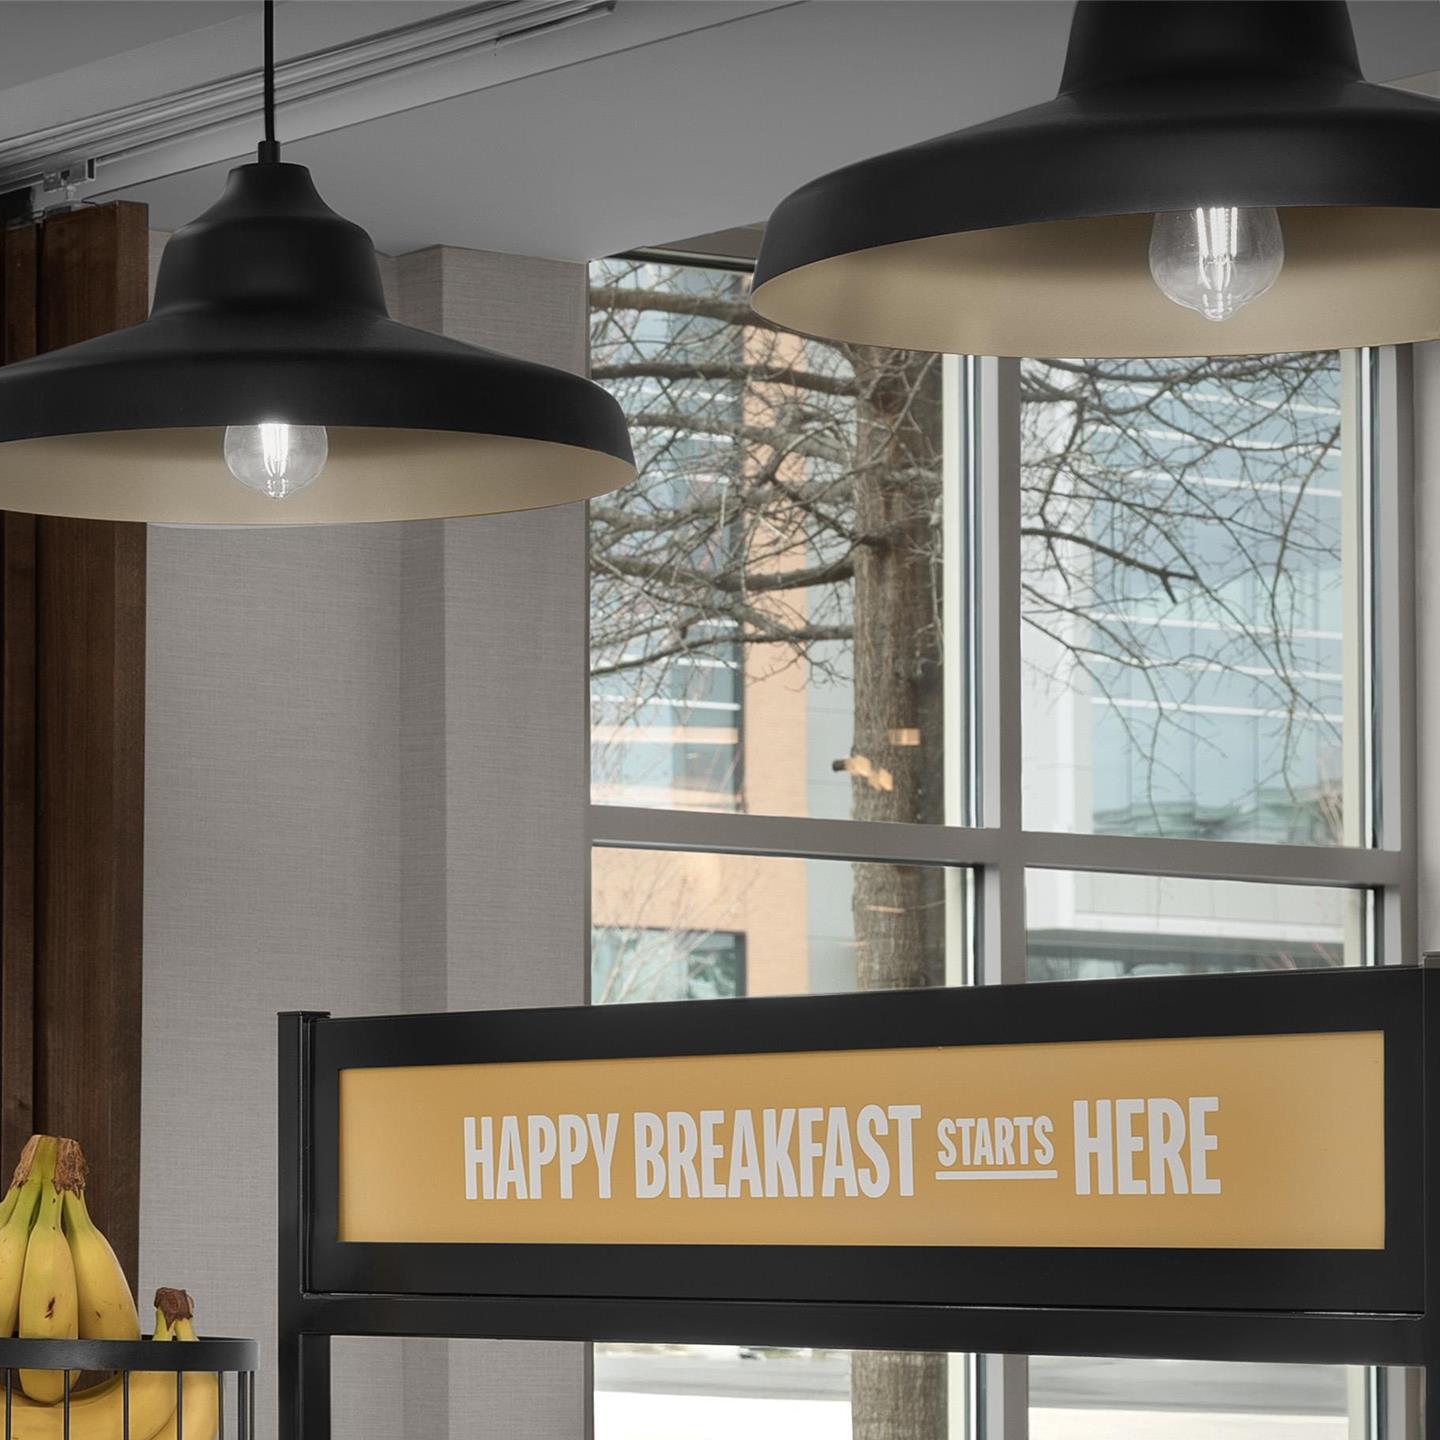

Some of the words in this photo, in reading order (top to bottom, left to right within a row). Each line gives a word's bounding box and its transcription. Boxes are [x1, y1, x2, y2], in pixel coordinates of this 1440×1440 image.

[463, 1112, 620, 1200] HAPPY
[633, 1103, 922, 1199] BREAKFAST
[936, 1115, 1056, 1168] STARTS
[1073, 1096, 1222, 1196] HERE
